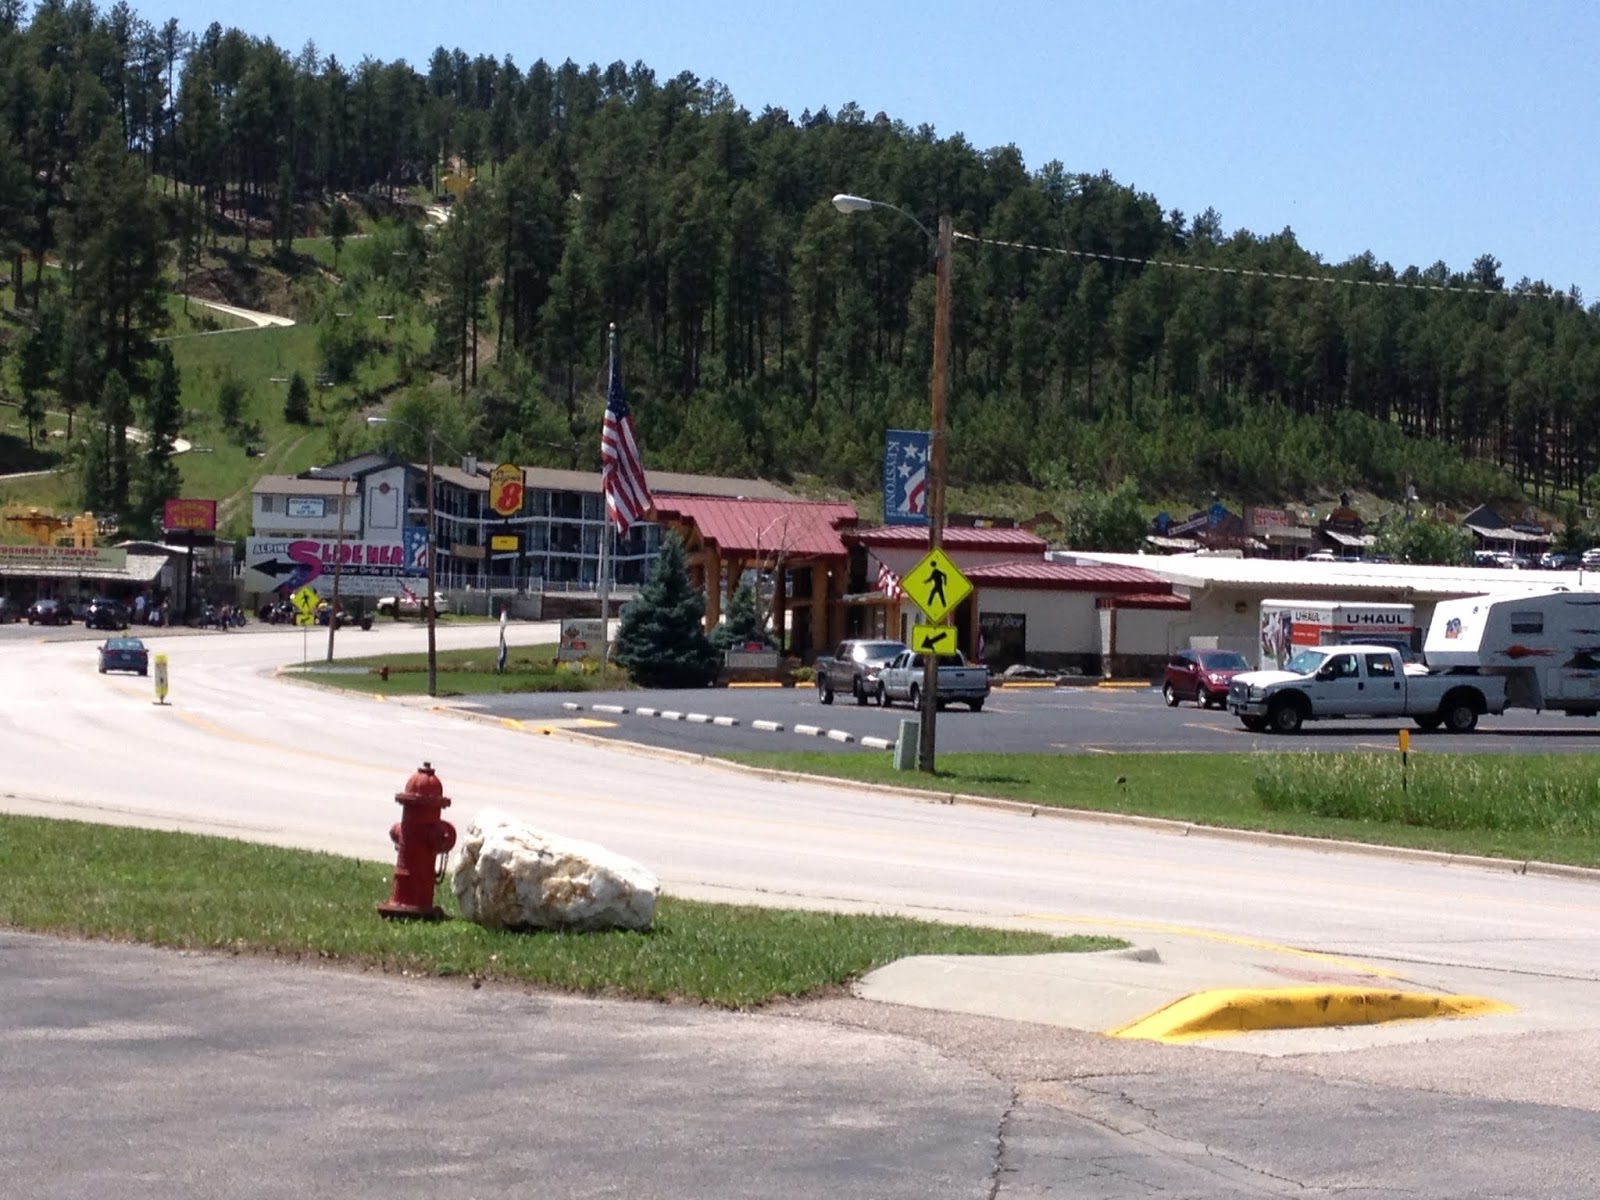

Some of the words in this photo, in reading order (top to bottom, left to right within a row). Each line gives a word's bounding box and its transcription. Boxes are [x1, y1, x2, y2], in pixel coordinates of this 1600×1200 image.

[252, 544, 291, 554] ALPINE
[1295, 611, 1320, 622] U-HAUL
[1347, 613, 1405, 624] U-HAUL
